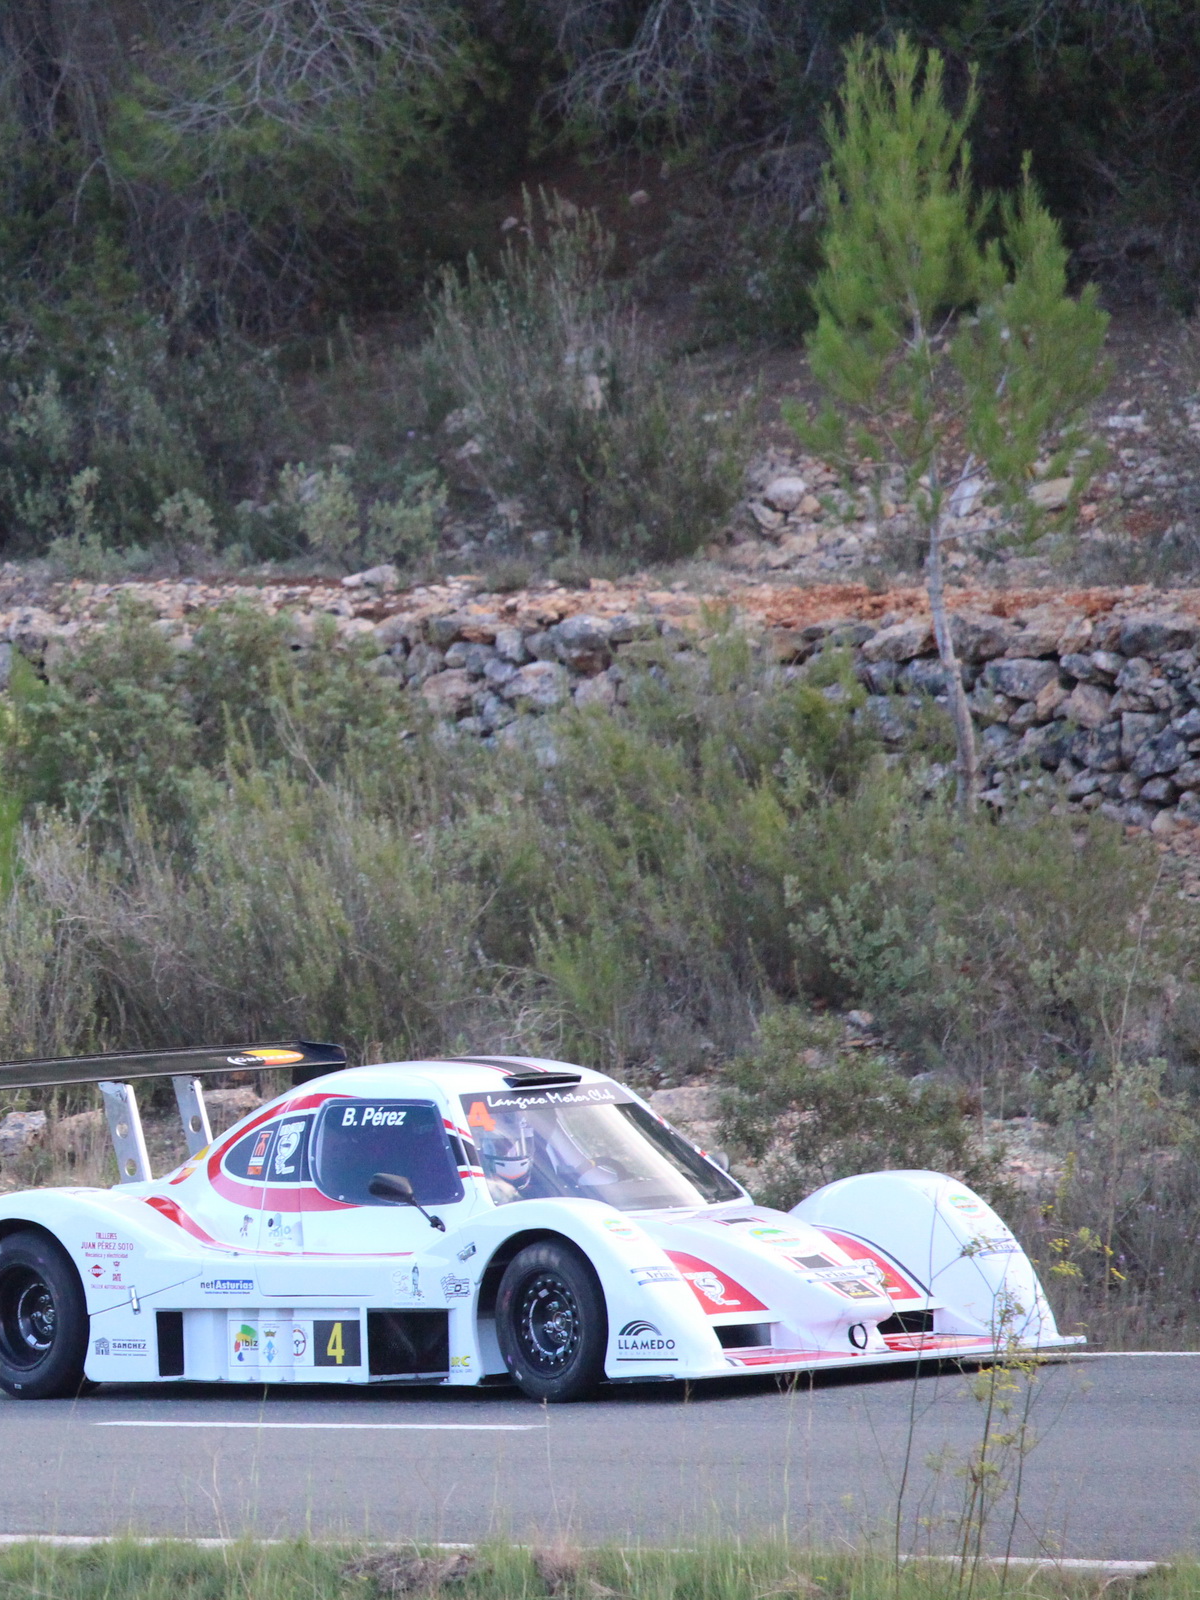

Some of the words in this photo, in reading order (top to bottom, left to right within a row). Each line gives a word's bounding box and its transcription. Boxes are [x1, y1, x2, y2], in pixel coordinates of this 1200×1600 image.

[487, 1094, 546, 1109] Langreo
[546, 1091, 590, 1104] Motor
[588, 1089, 615, 1101] Club
[341, 1107, 358, 1126] B.
[361, 1106, 407, 1126] Pérez
[468, 1102, 496, 1131] 4
[81, 1241, 96, 1250] JUAN
[97, 1241, 117, 1250] PÉREZ
[117, 1243, 134, 1251] SOTO
[326, 1322, 345, 1364] 4
[618, 1339, 675, 1350] LLAMEDO
